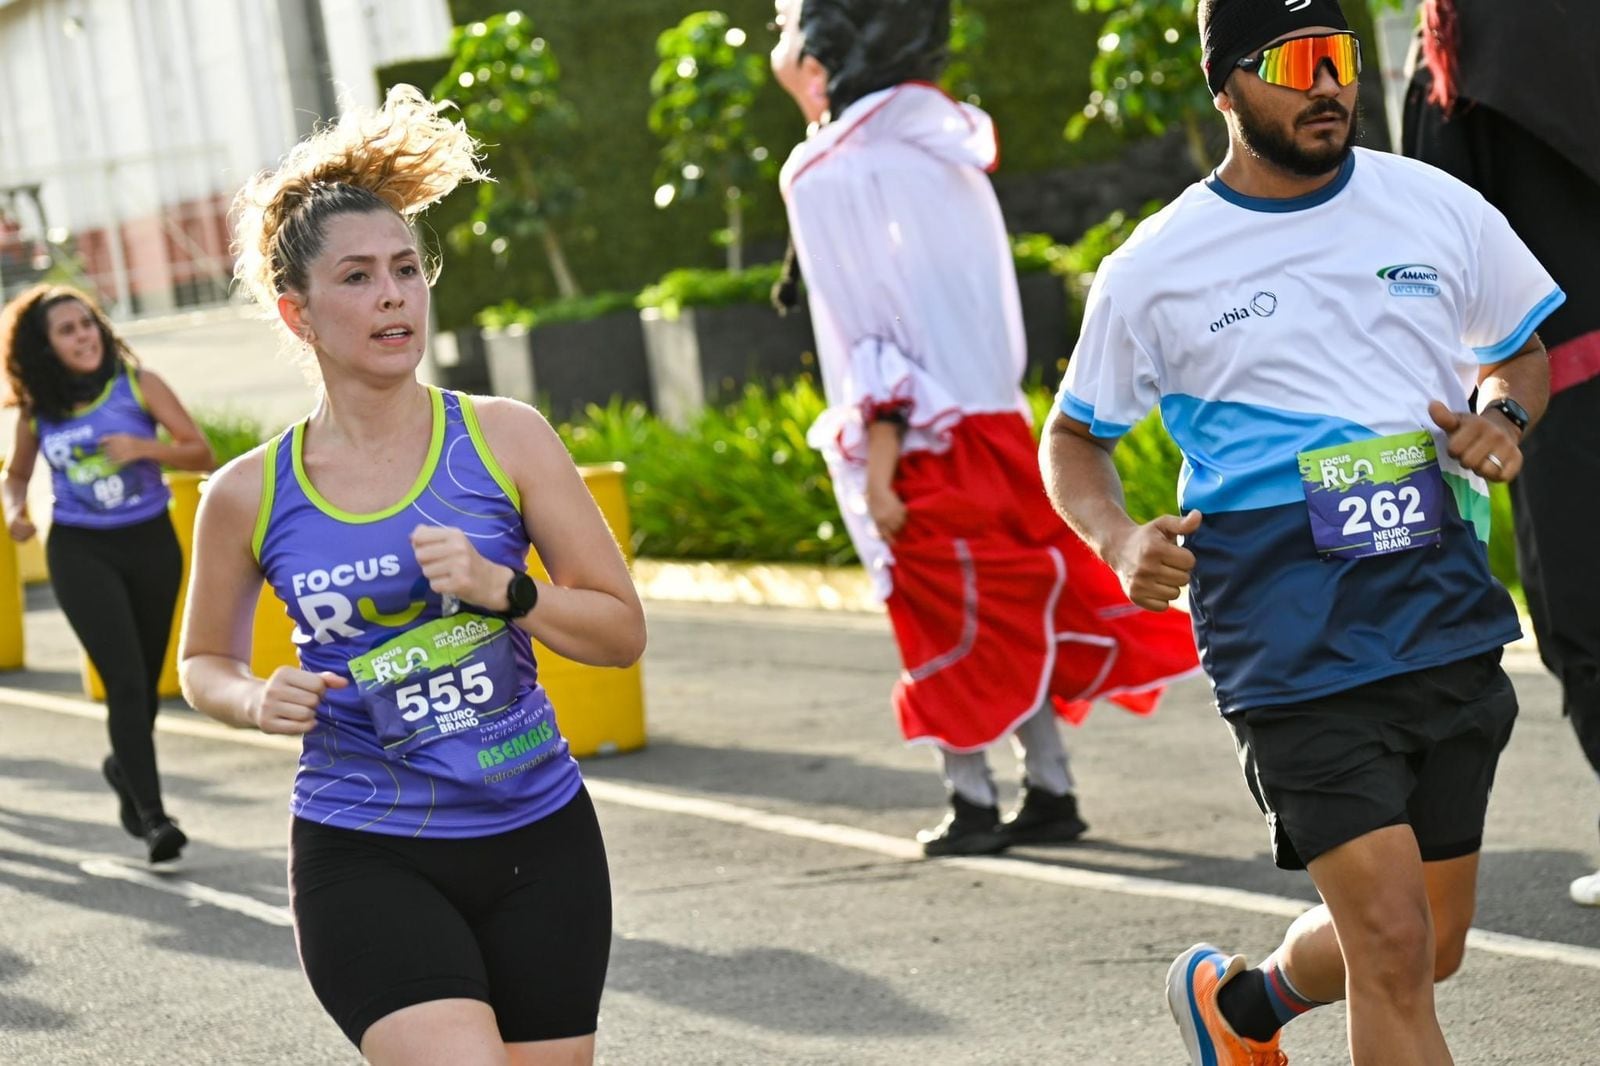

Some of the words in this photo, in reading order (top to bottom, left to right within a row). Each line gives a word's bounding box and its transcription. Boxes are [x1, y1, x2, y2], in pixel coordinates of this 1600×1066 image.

[1400, 271, 1438, 281] AMANCO
[1393, 285, 1435, 294] wavin
[1210, 307, 1250, 333] orbia
[1319, 454, 1351, 467] FOCUS
[1338, 486, 1426, 536] 262
[1375, 536, 1412, 552] BRAND
[292, 554, 400, 597] FOCUS
[434, 622, 489, 649] KILOMETROS
[371, 646, 403, 666] FOCUS
[395, 661, 494, 722] 555
[439, 717, 480, 734] BRAND
[481, 719, 523, 743] HACIENDA
[477, 720, 555, 770] ASEMBIS
[484, 750, 549, 786] Patrocinador
